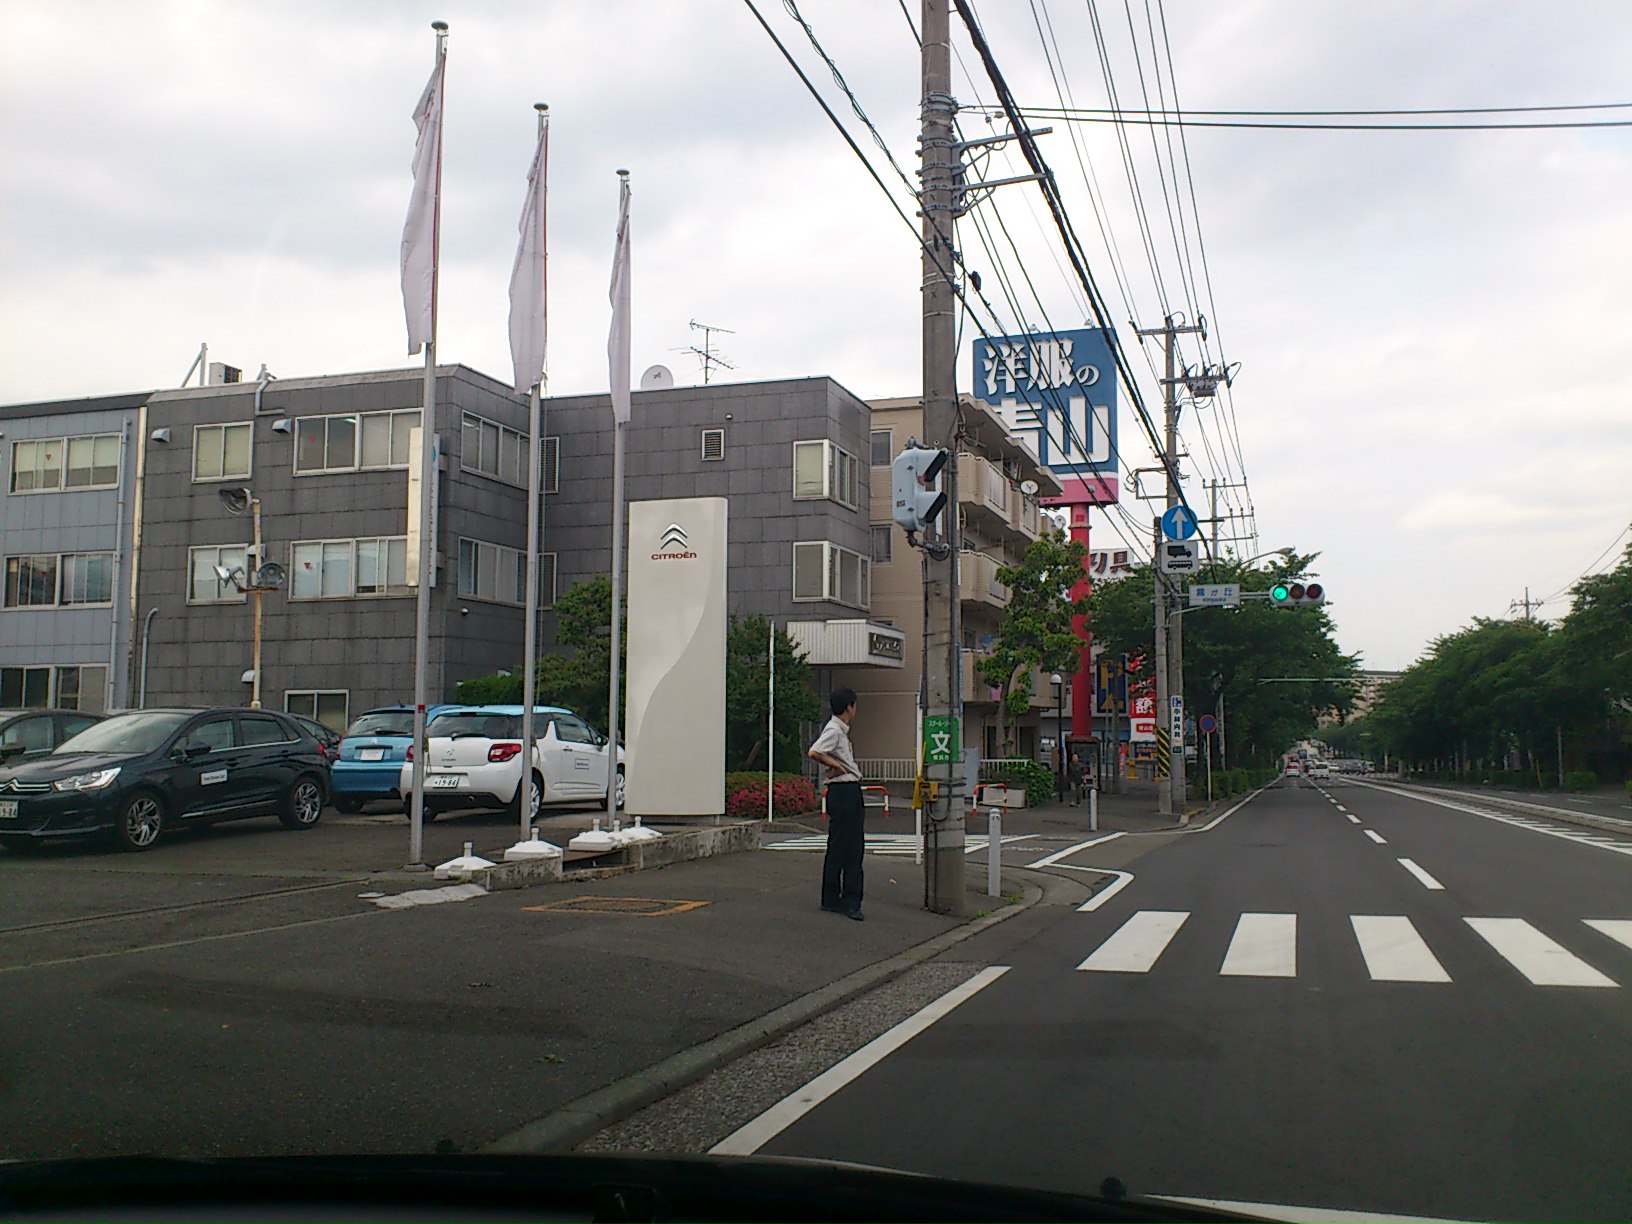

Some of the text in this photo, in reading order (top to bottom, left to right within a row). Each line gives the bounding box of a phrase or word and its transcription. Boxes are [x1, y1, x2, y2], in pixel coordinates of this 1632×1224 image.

[981, 336, 1099, 396] 洋服の
[989, 395, 1110, 466] 青山
[930, 730, 951, 755] 文
